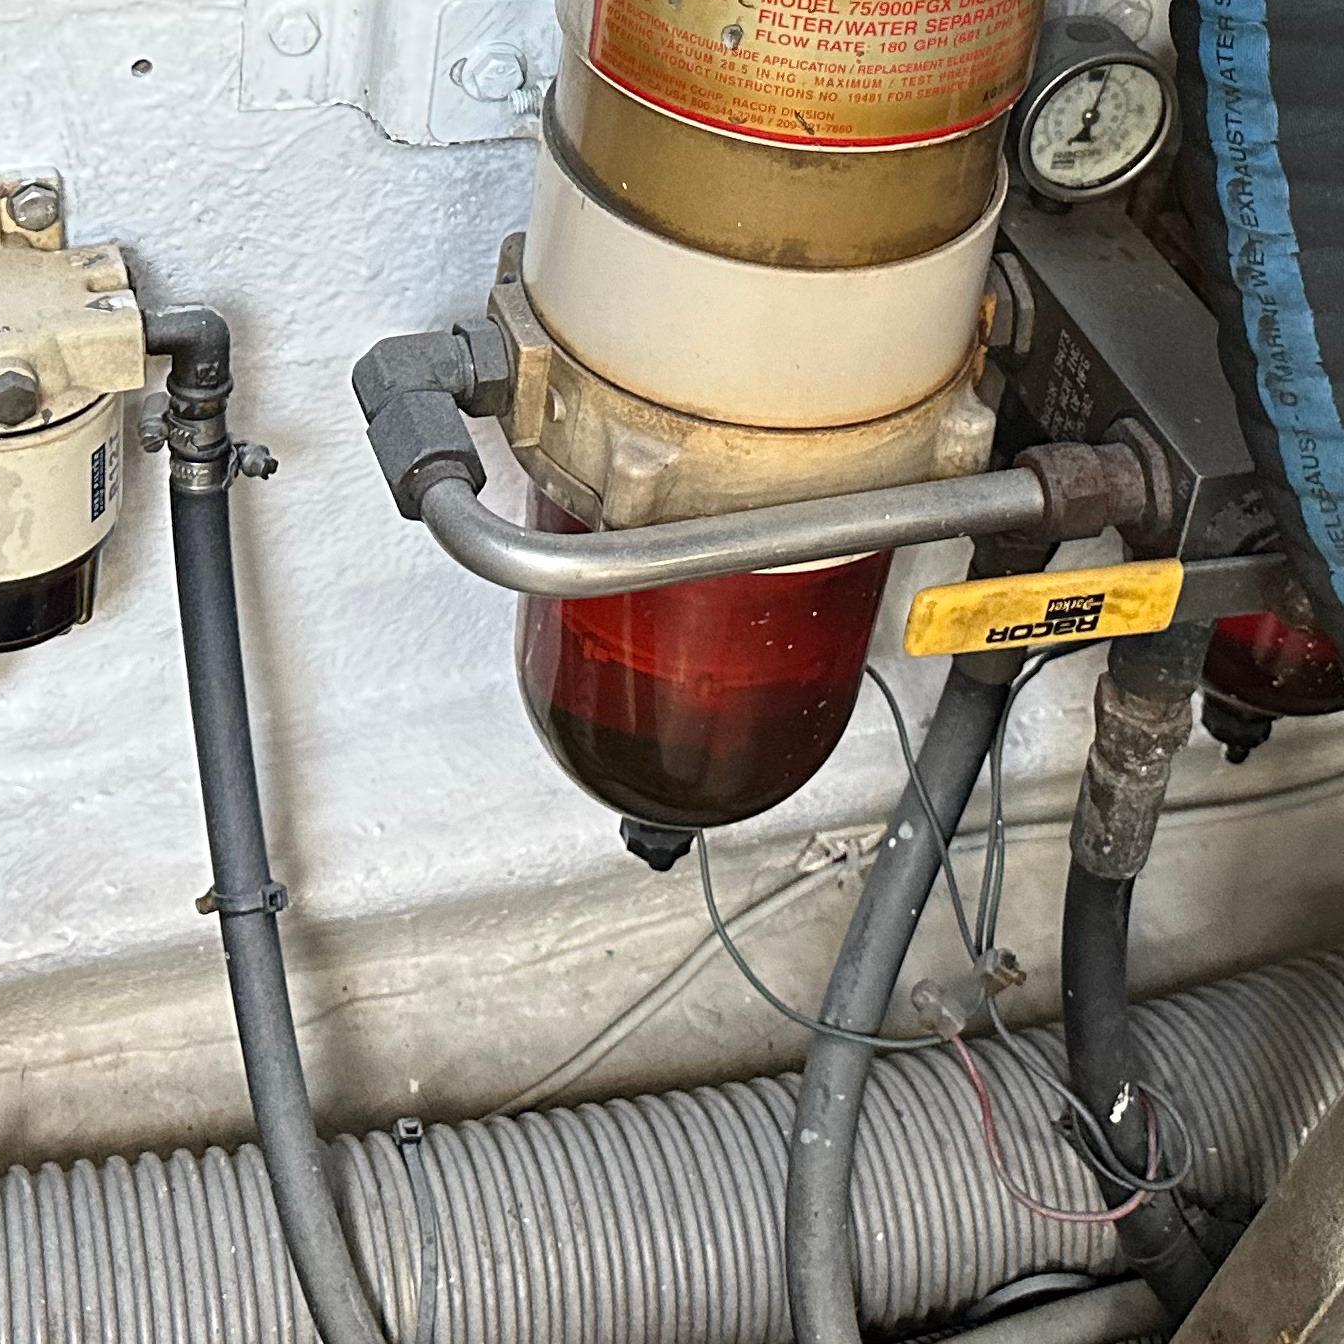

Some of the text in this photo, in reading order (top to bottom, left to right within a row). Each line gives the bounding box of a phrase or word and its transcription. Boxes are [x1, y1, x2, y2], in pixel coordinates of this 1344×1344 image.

[758, 9, 918, 36] FILTER/WATER
[755, 29, 810, 49] FLOW
[879, 41, 906, 53] 180
[913, 37, 948, 51] GPH
[762, 54, 846, 74] APPLICATION
[714, 72, 814, 101] INSTRUCTIONS
[814, 76, 882, 89] MAXIMUM
